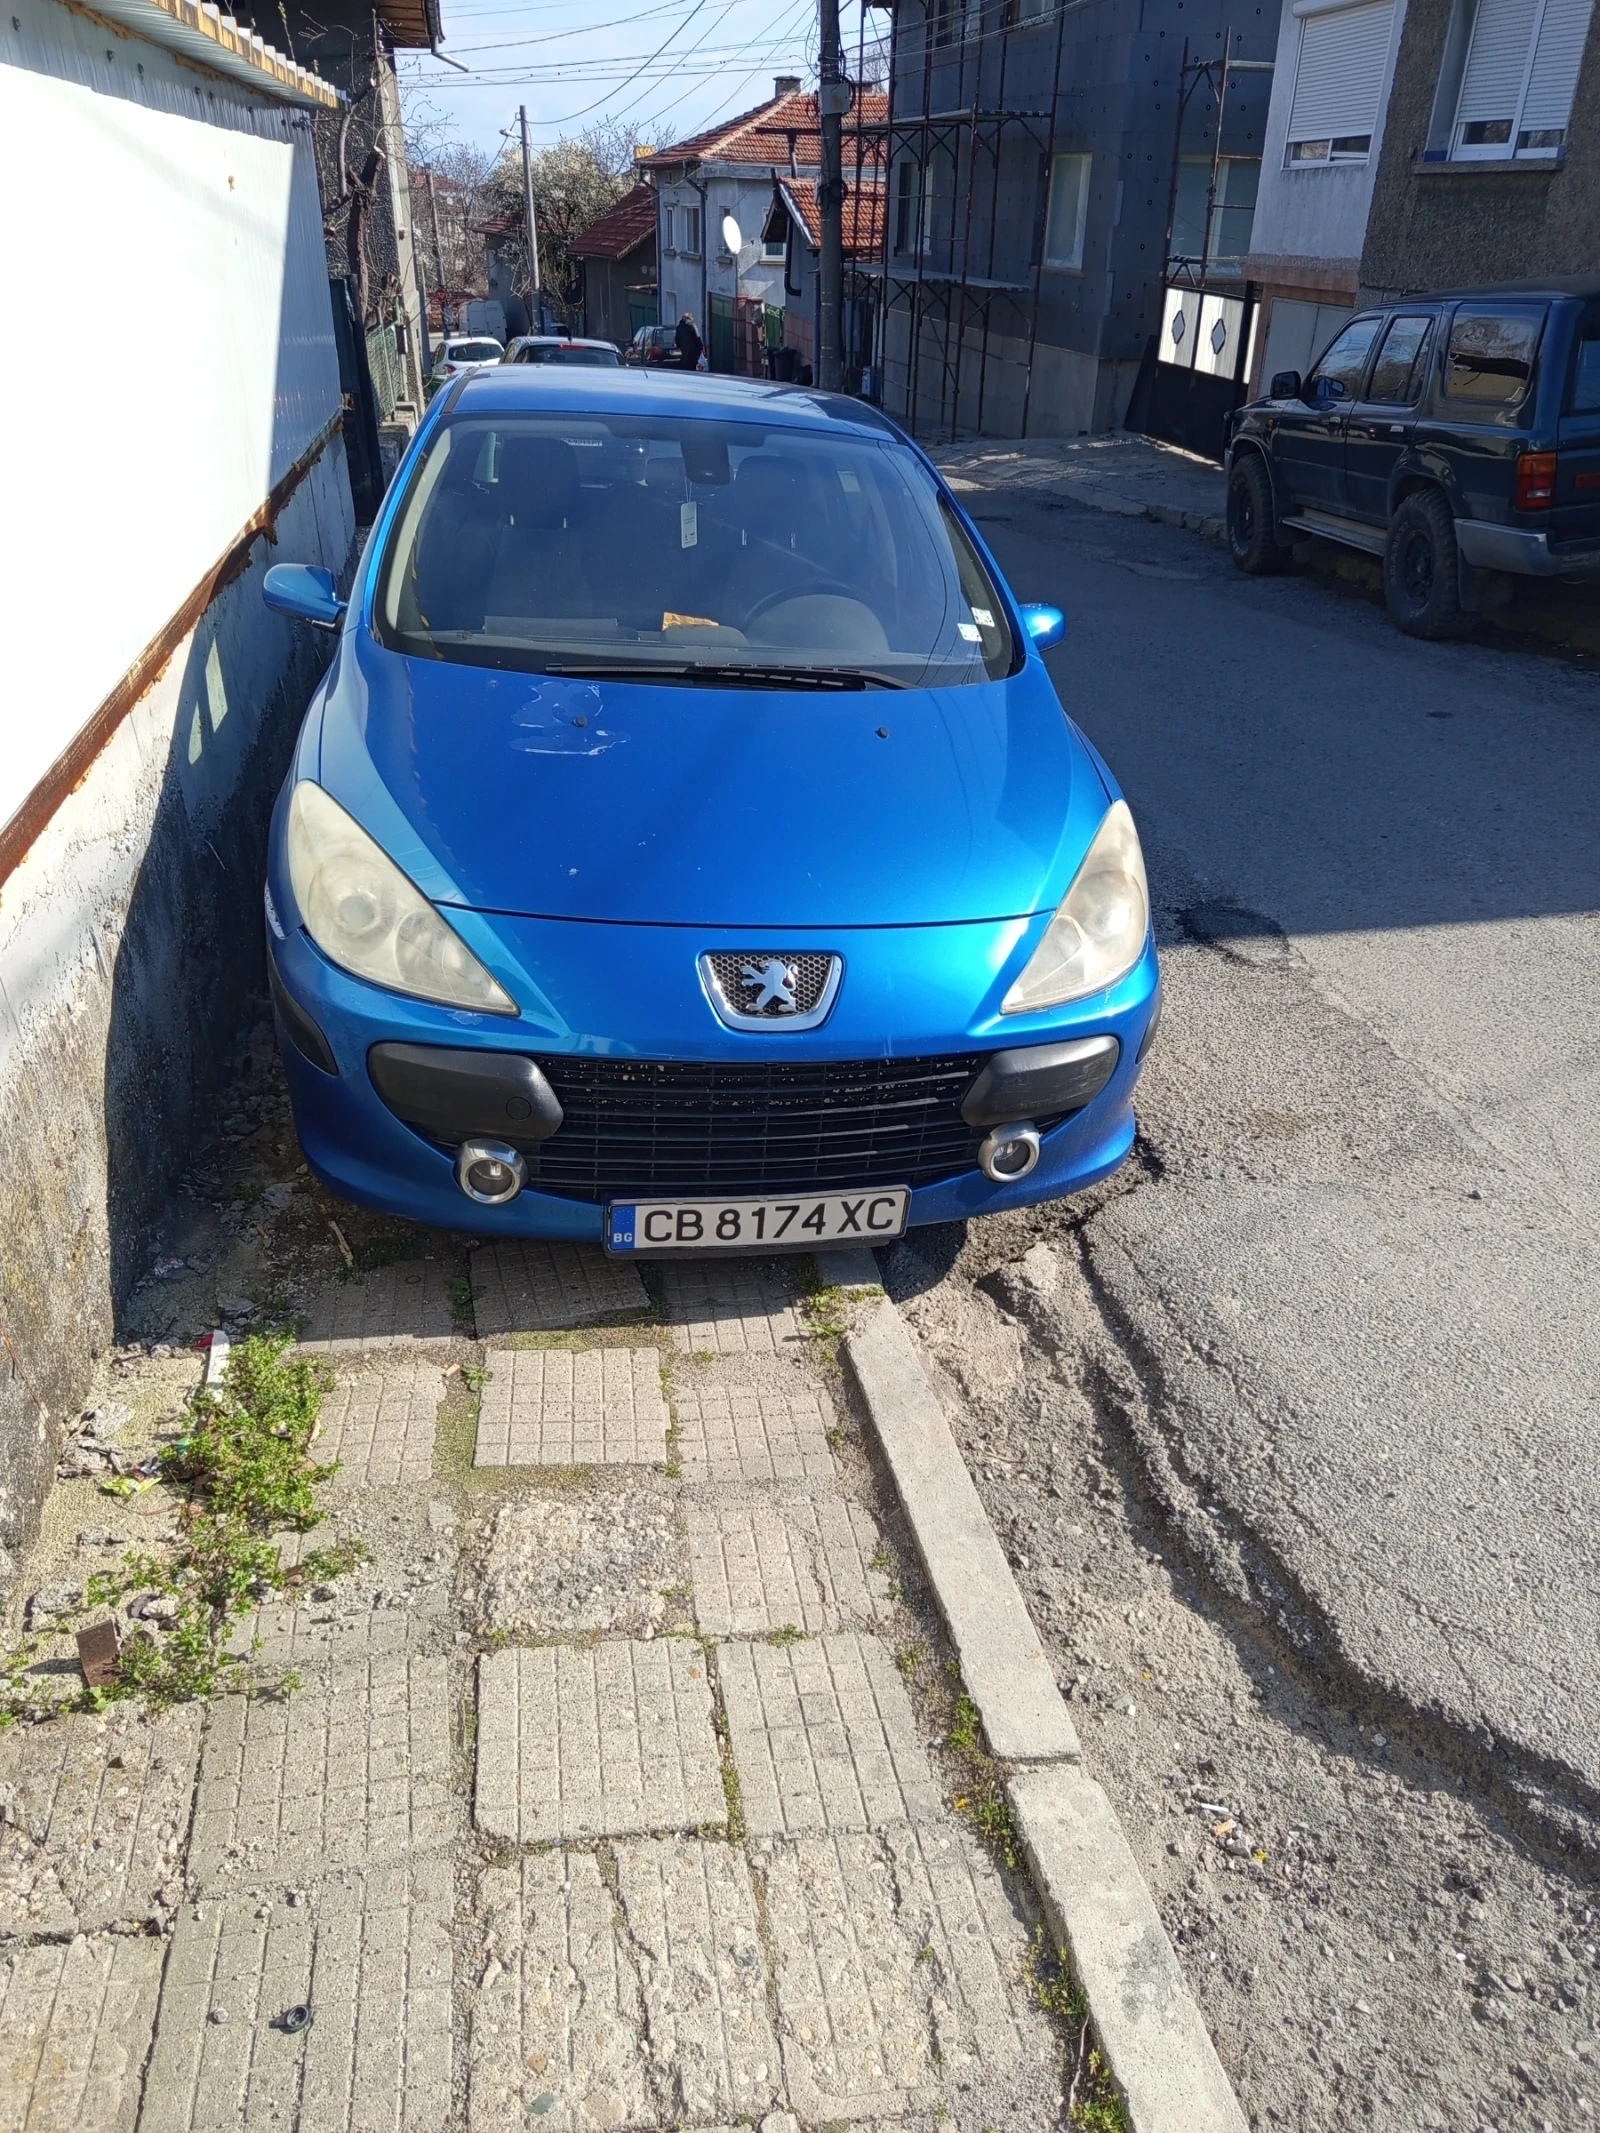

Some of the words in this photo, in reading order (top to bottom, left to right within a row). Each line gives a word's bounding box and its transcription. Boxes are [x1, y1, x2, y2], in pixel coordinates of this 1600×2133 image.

[644, 1209, 704, 1242] CB
[715, 1203, 826, 1241] 8174
[836, 1197, 896, 1234] XC
[613, 1232, 633, 1243] BG
